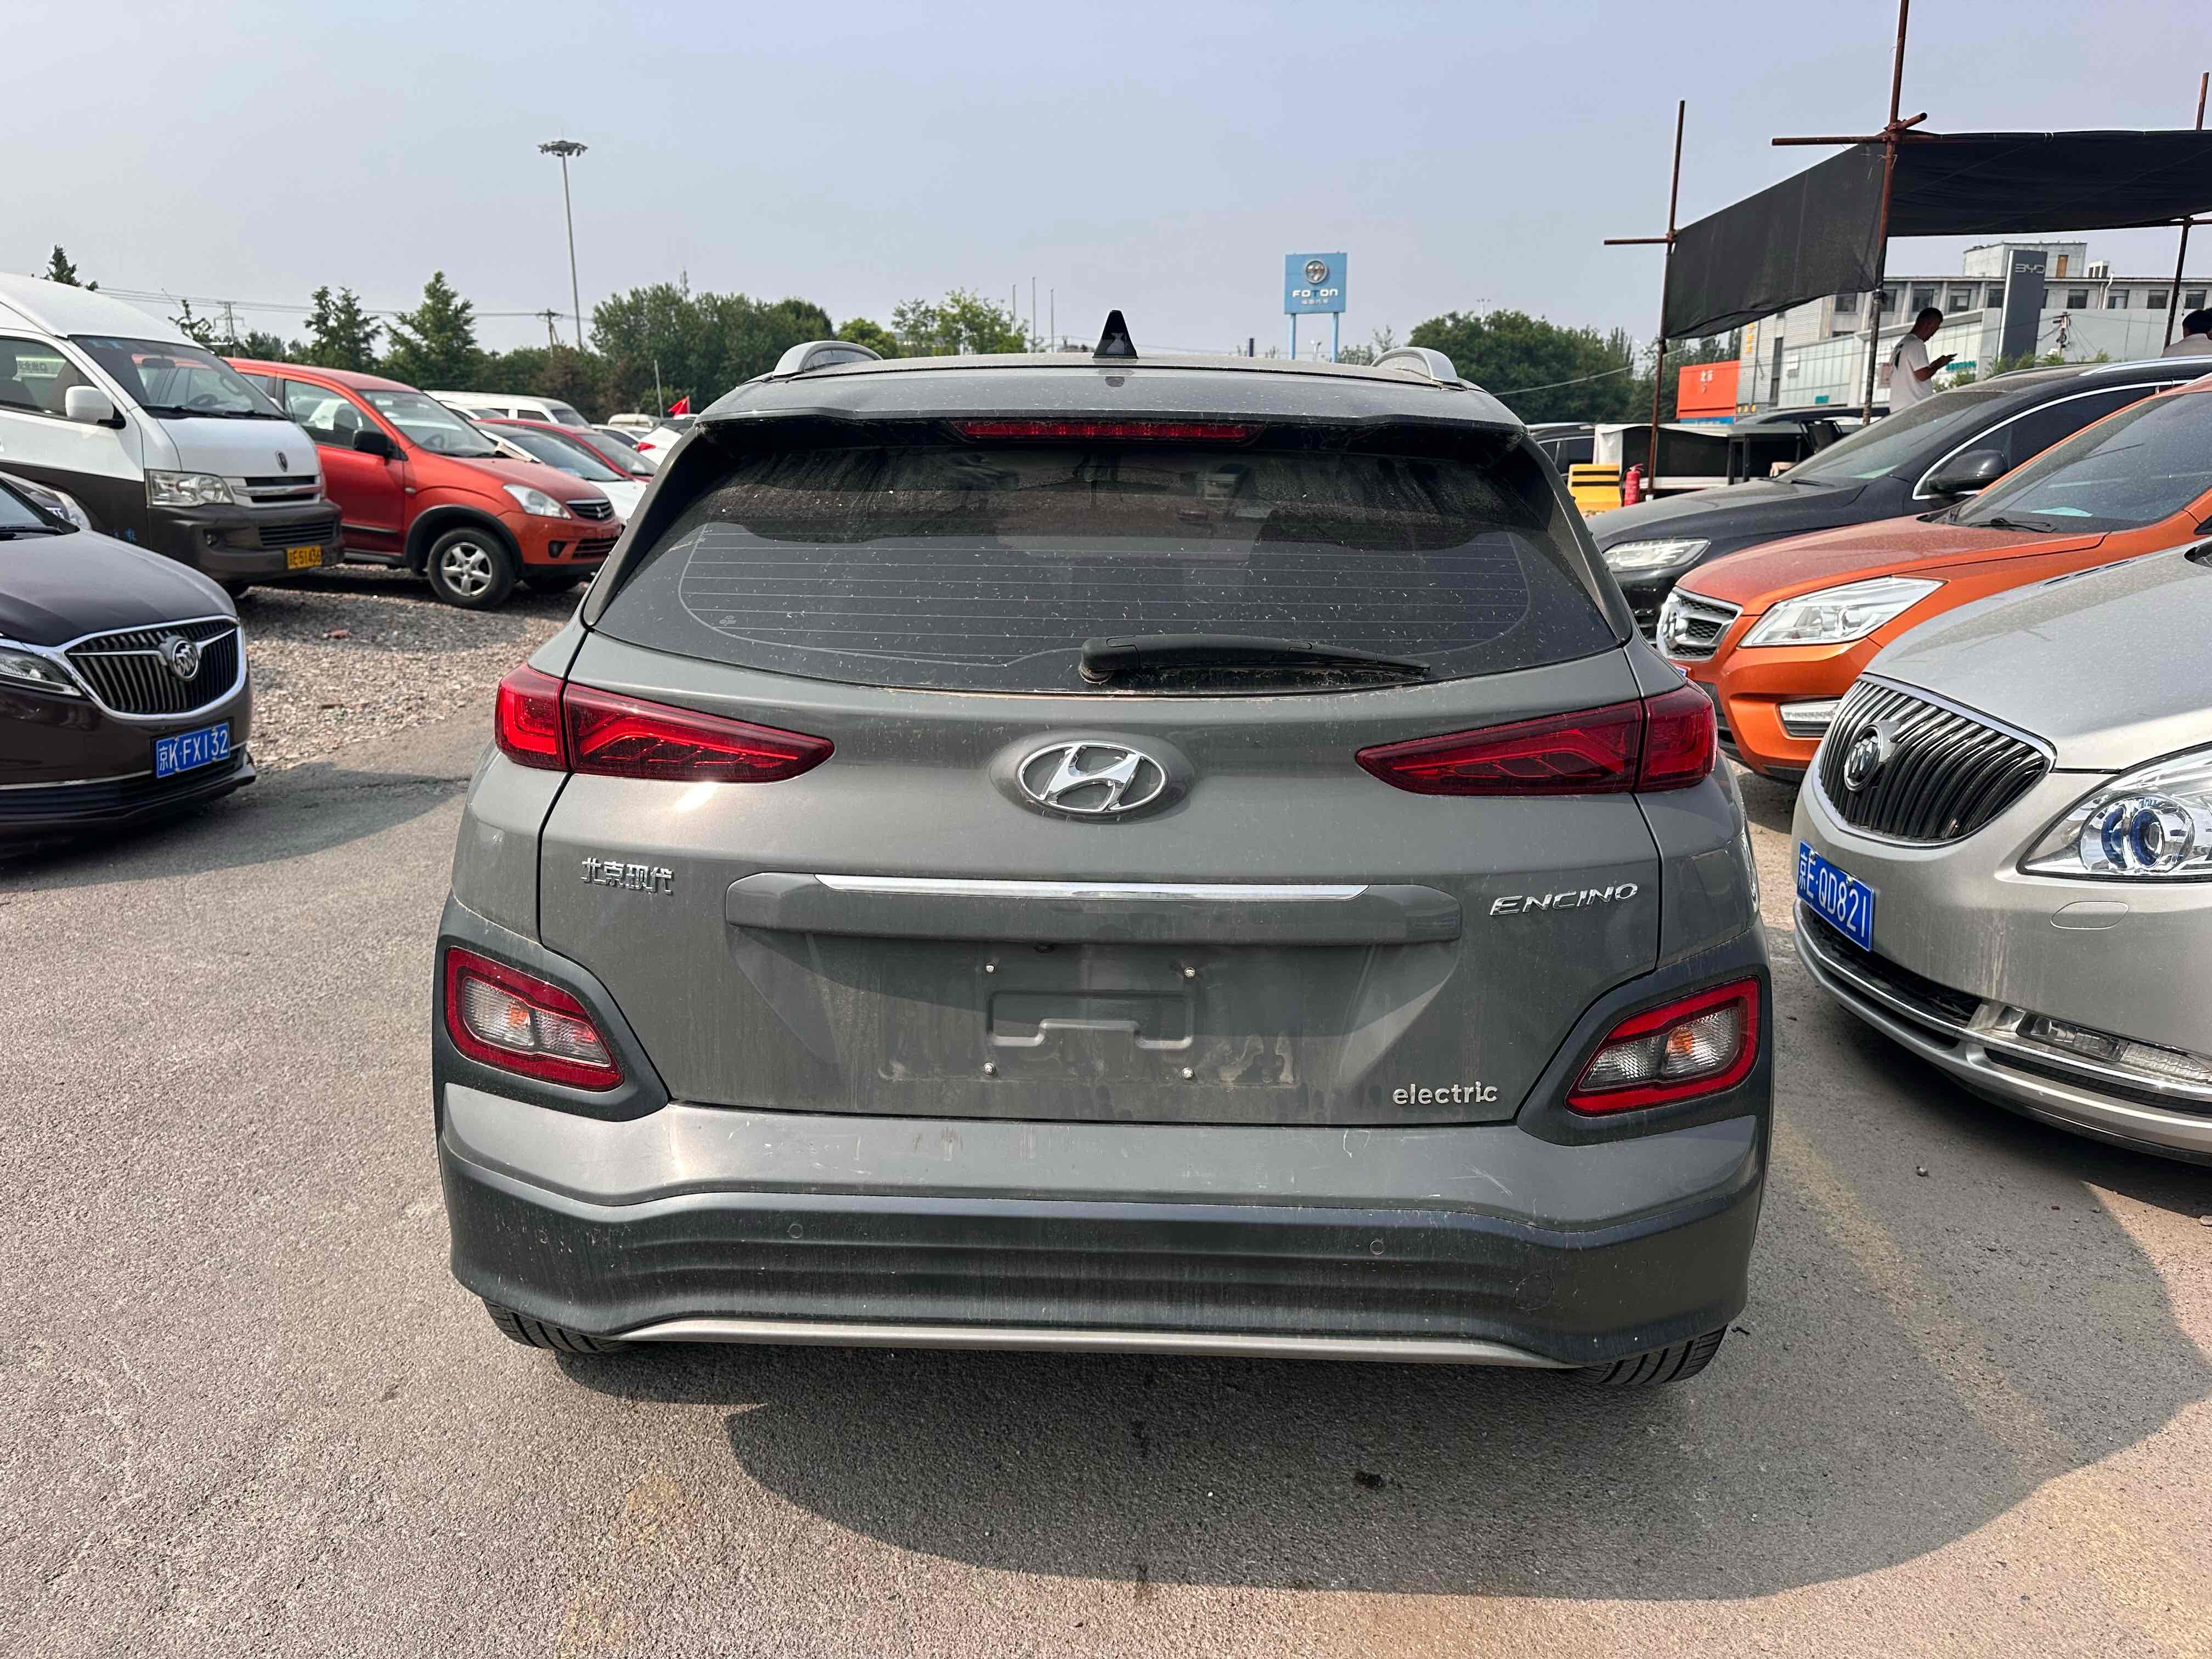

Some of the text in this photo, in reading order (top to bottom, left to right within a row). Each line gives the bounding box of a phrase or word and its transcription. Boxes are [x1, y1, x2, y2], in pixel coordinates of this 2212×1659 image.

[2015, 264, 2045, 273] BYD
[580, 857, 674, 894] 北京现代
[1489, 883, 1638, 915] ENCINO
[1392, 1081, 1498, 1104] electric
